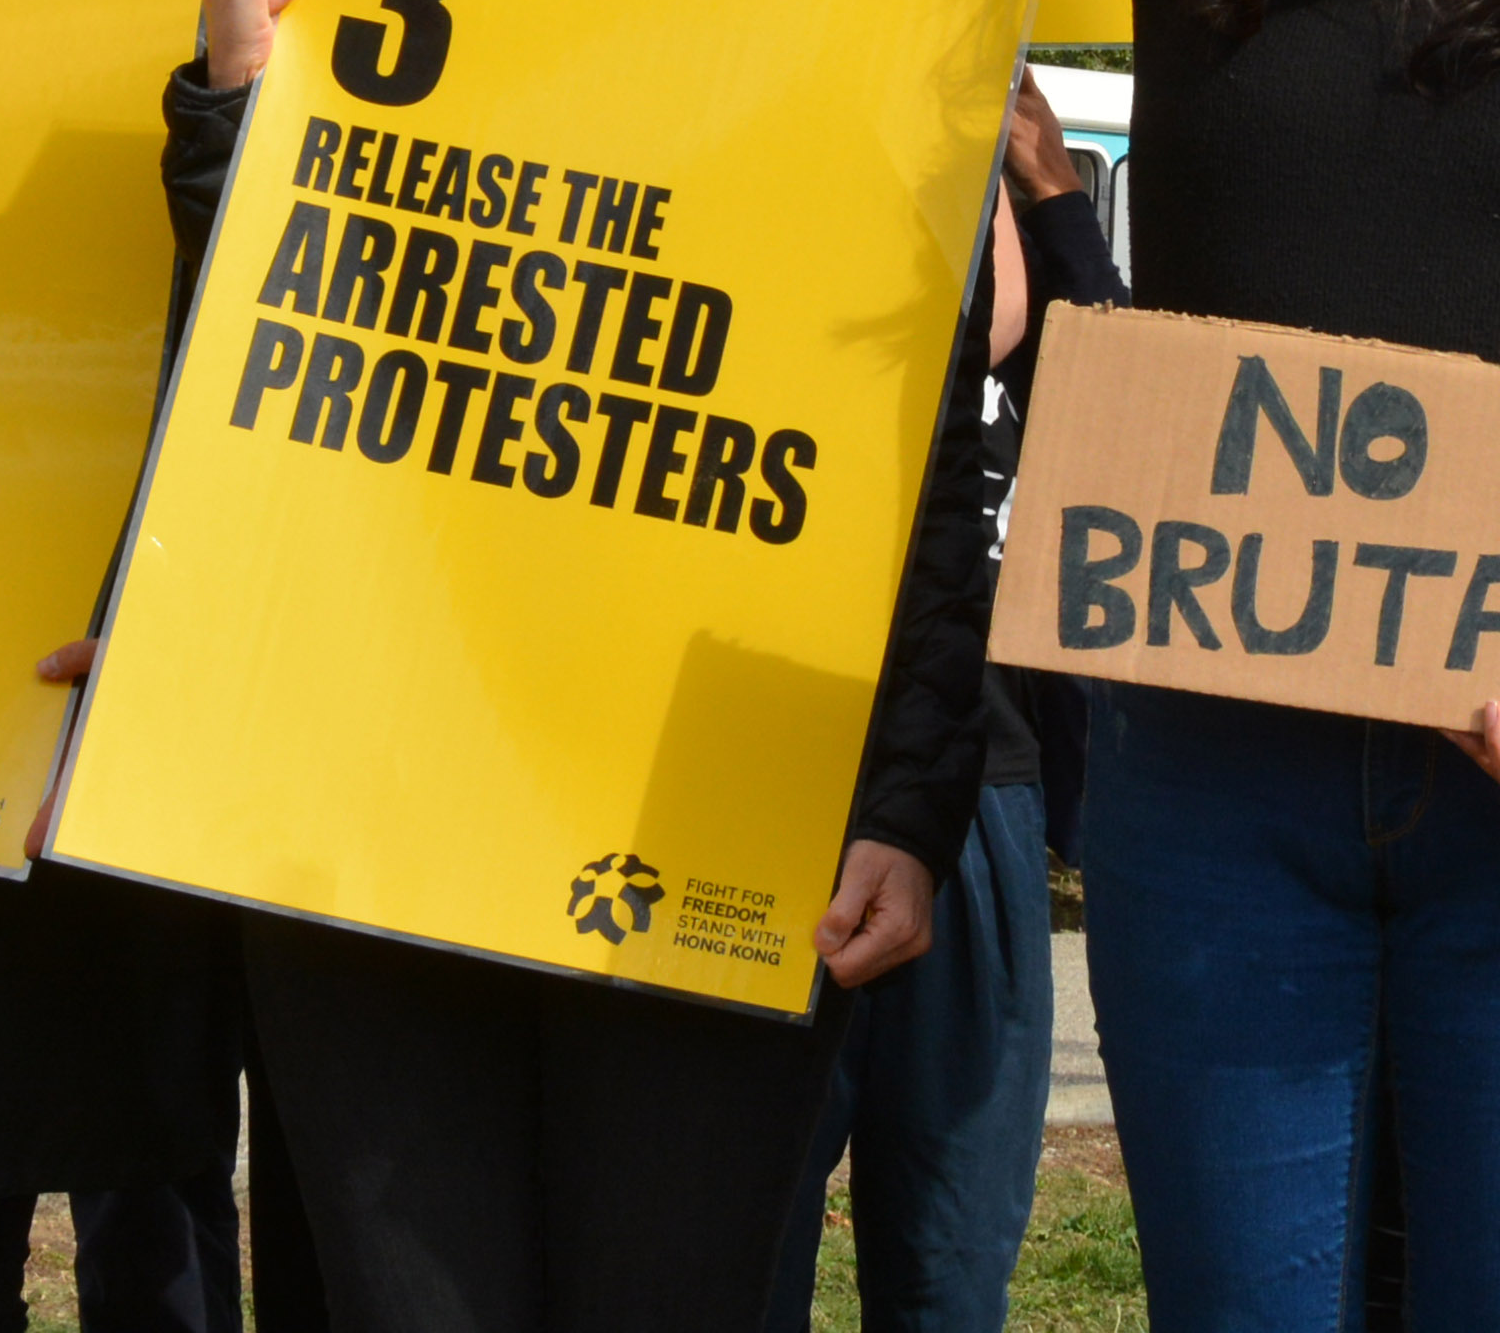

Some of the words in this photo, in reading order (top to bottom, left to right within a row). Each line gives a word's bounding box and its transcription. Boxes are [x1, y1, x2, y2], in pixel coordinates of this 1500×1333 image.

[291, 115, 550, 236] RELEASE
[558, 168, 673, 261] THE
[257, 201, 734, 396] ARRESTED
[230, 317, 818, 545] PROTESTERS
[1209, 355, 1427, 502] NO
[677, 915, 736, 937] STAND
[741, 927, 785, 948] WITH
[682, 896, 767, 925] FREEDOM
[685, 878, 738, 900] FIGHT
[741, 889, 775, 909] FOR
[673, 932, 726, 955] HONG
[729, 943, 780, 966] KONG
